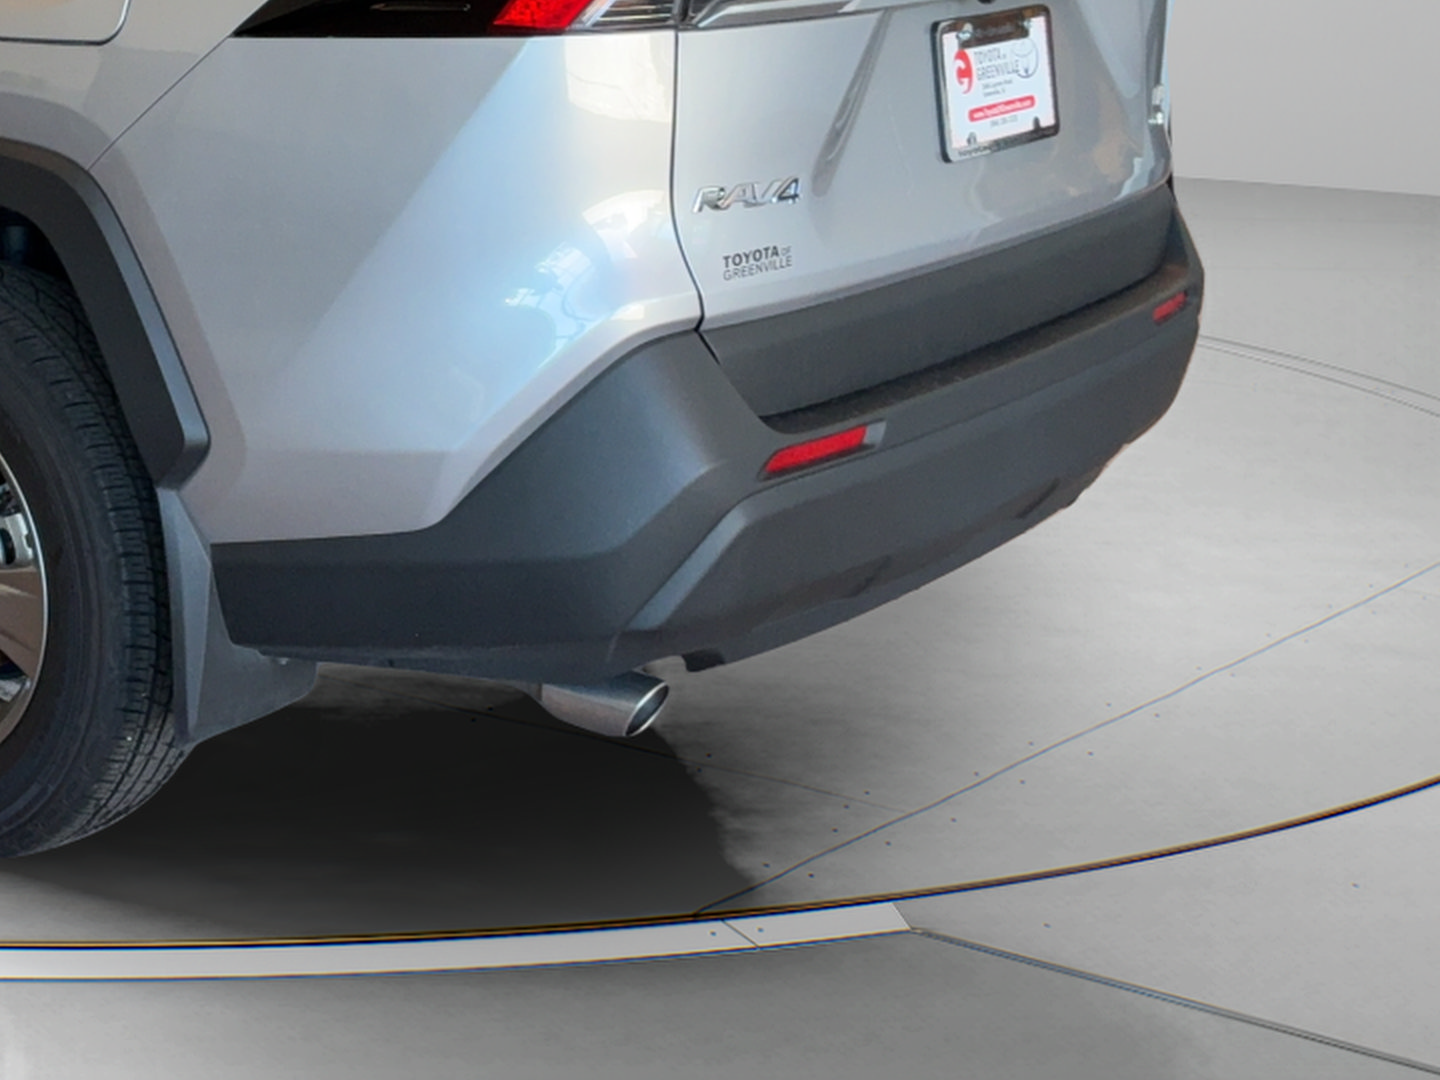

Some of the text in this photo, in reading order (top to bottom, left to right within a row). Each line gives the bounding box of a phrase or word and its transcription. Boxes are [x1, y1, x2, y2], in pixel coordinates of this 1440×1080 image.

[692, 176, 800, 213] RAV4
[723, 246, 779, 268] TOYOTA
[723, 256, 792, 281] GREENVILLE
